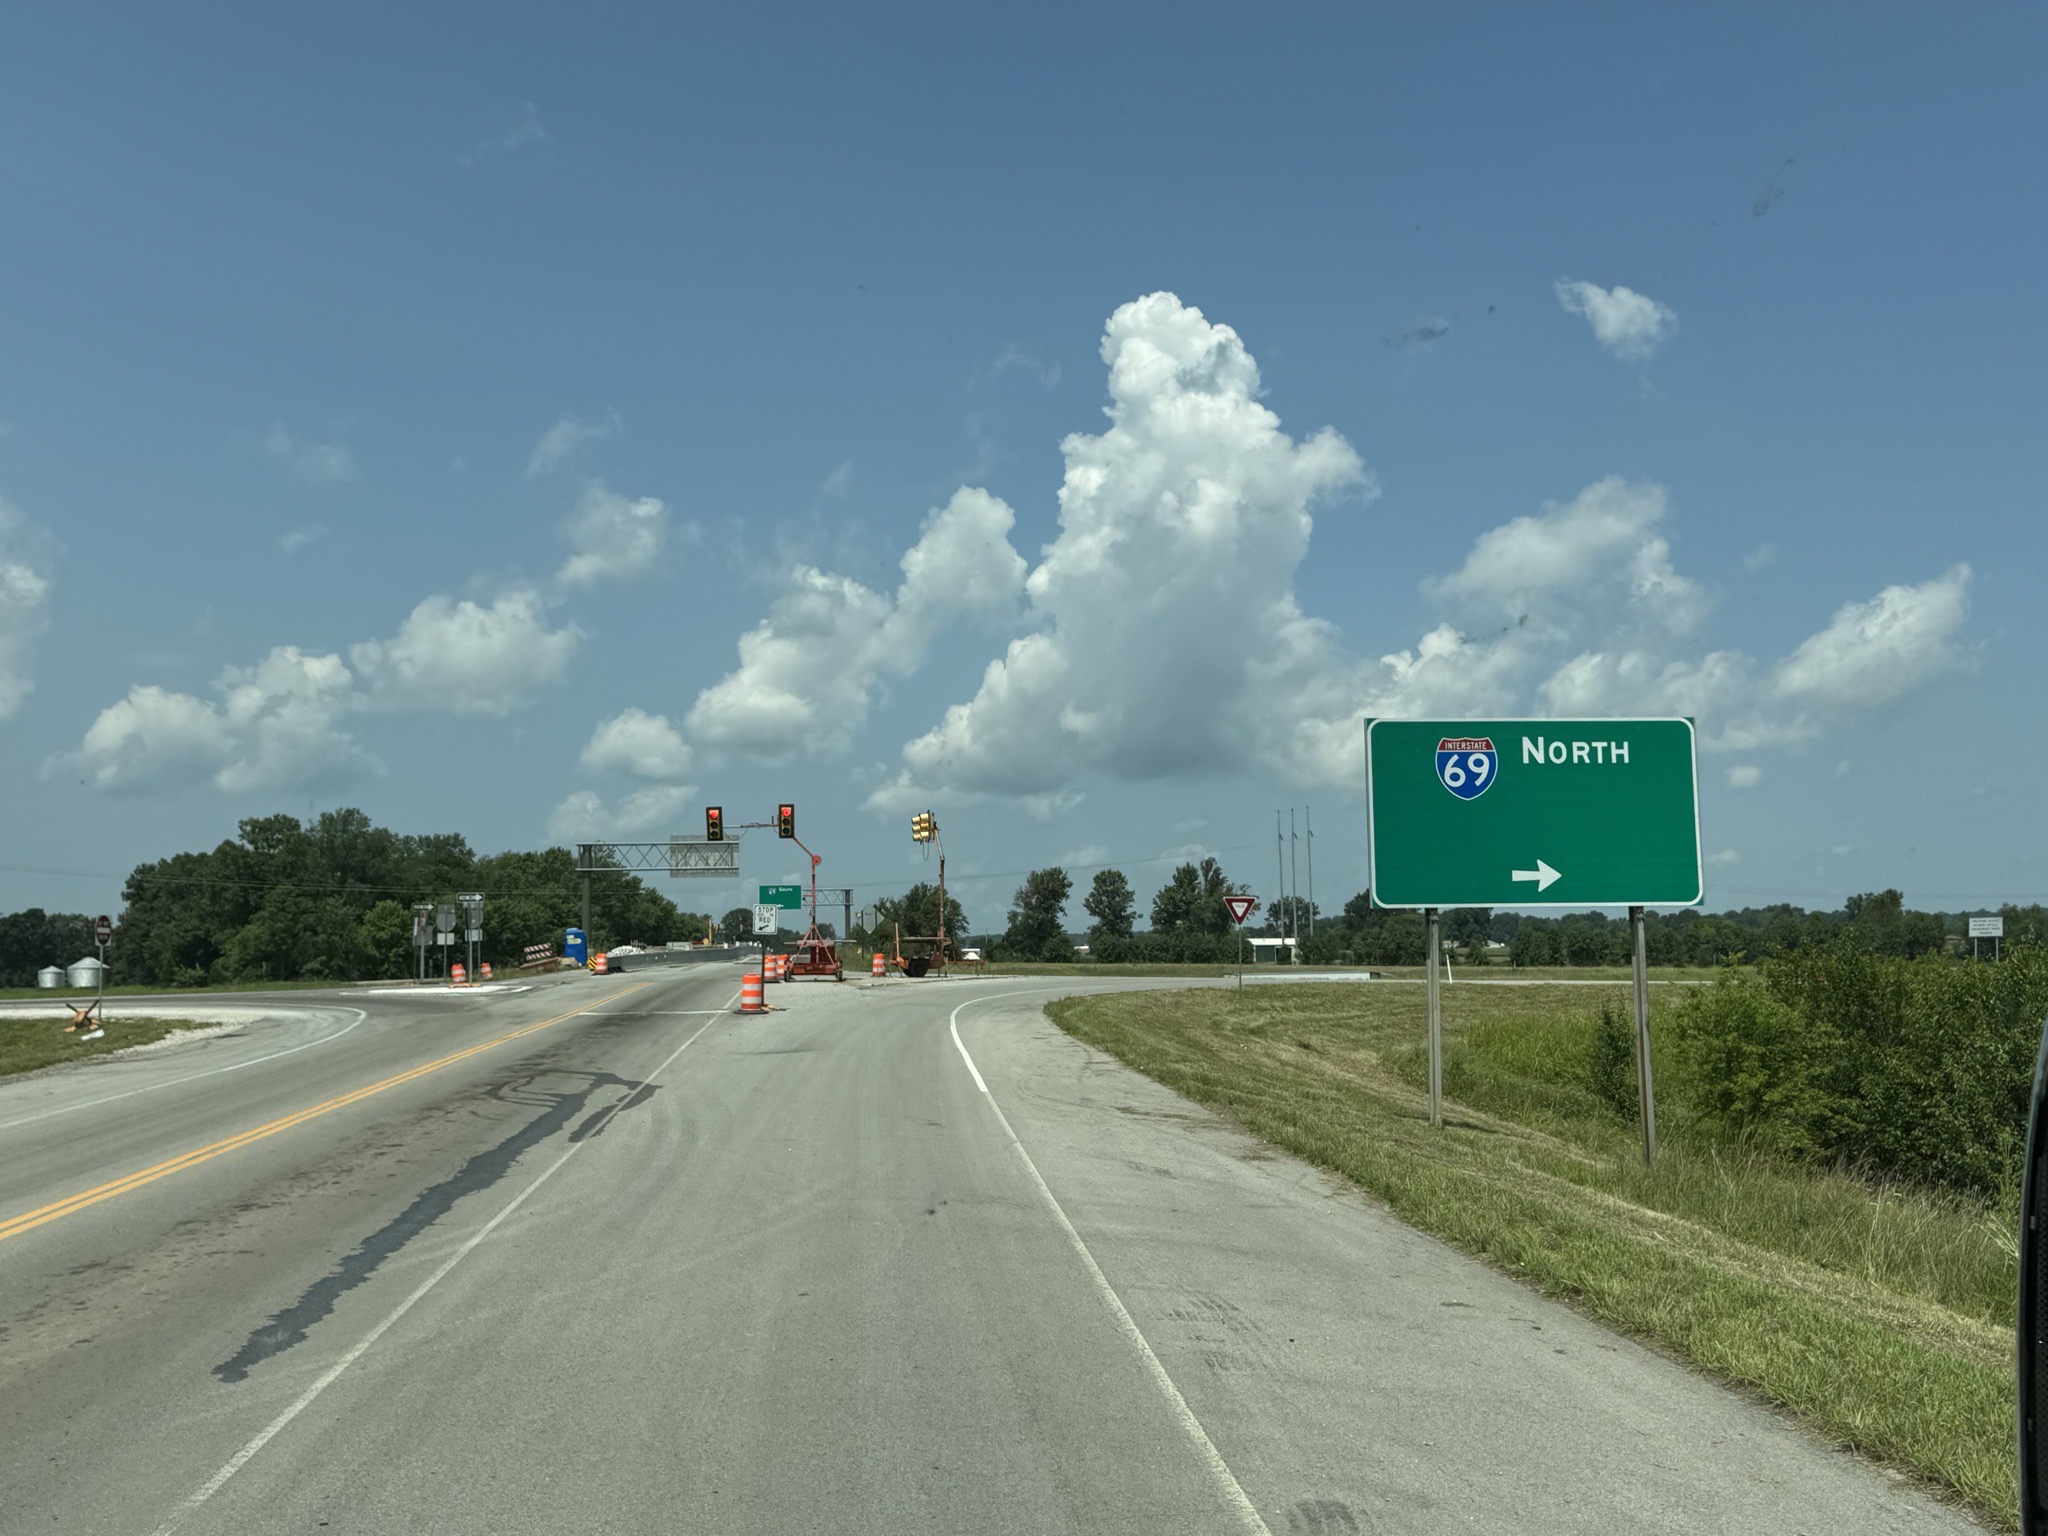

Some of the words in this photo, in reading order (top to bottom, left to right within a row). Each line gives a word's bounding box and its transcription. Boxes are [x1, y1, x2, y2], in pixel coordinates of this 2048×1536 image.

[1444, 741, 1487, 750] INTERSTATE
[1522, 736, 1630, 764] NORTH
[1444, 753, 1490, 787] 69
